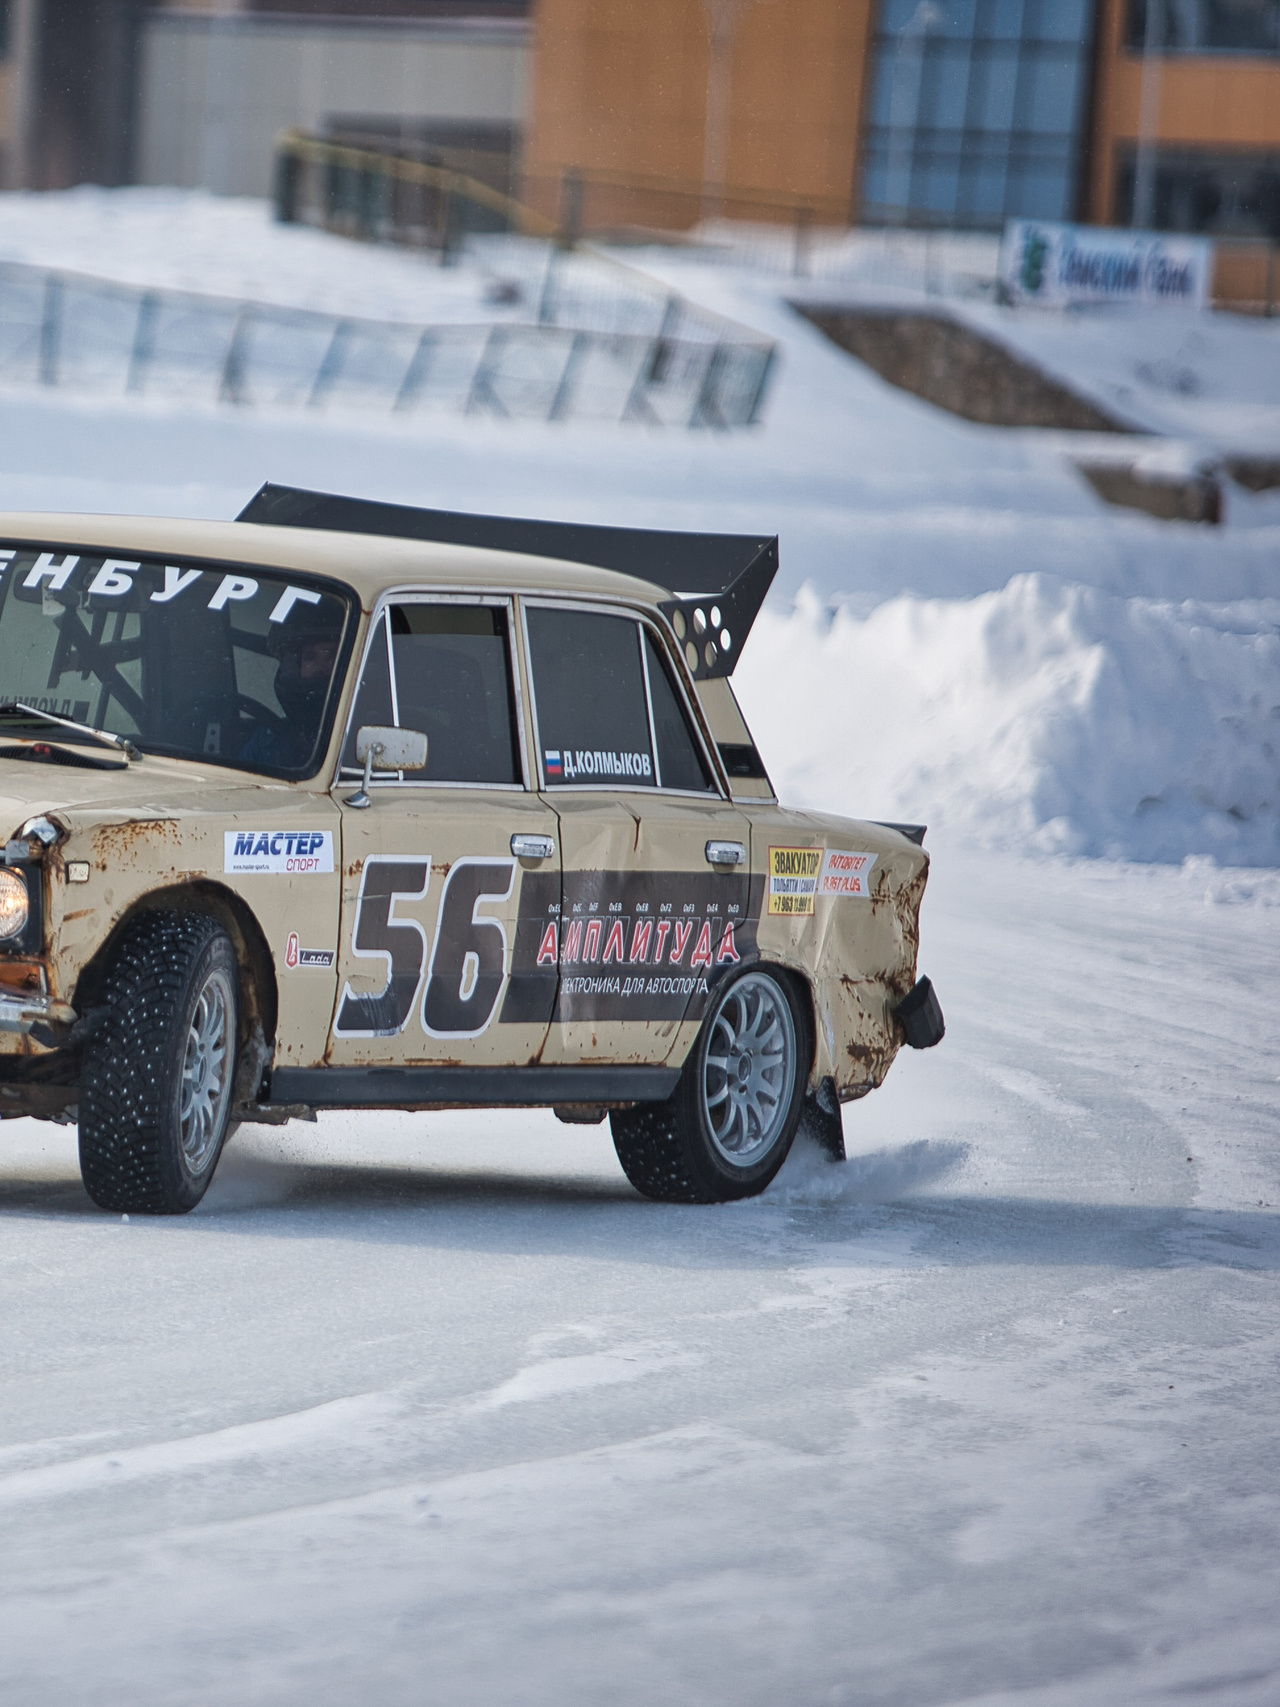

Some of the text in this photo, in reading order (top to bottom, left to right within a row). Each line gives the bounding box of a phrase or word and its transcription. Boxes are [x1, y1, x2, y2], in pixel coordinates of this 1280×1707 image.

[563, 750, 651, 777] Д.КОЛМЫКОВ
[233, 832, 324, 855] МАСТЕР
[286, 858, 320, 871] СПОРТ
[774, 851, 820, 875] ЭВАКУАТОР
[332, 854, 518, 1040] 56
[537, 920, 740, 968] АМПЛИТУДА
[621, 978, 645, 996] ДЛЯ
[645, 977, 709, 994] АВТОСПОРТА
